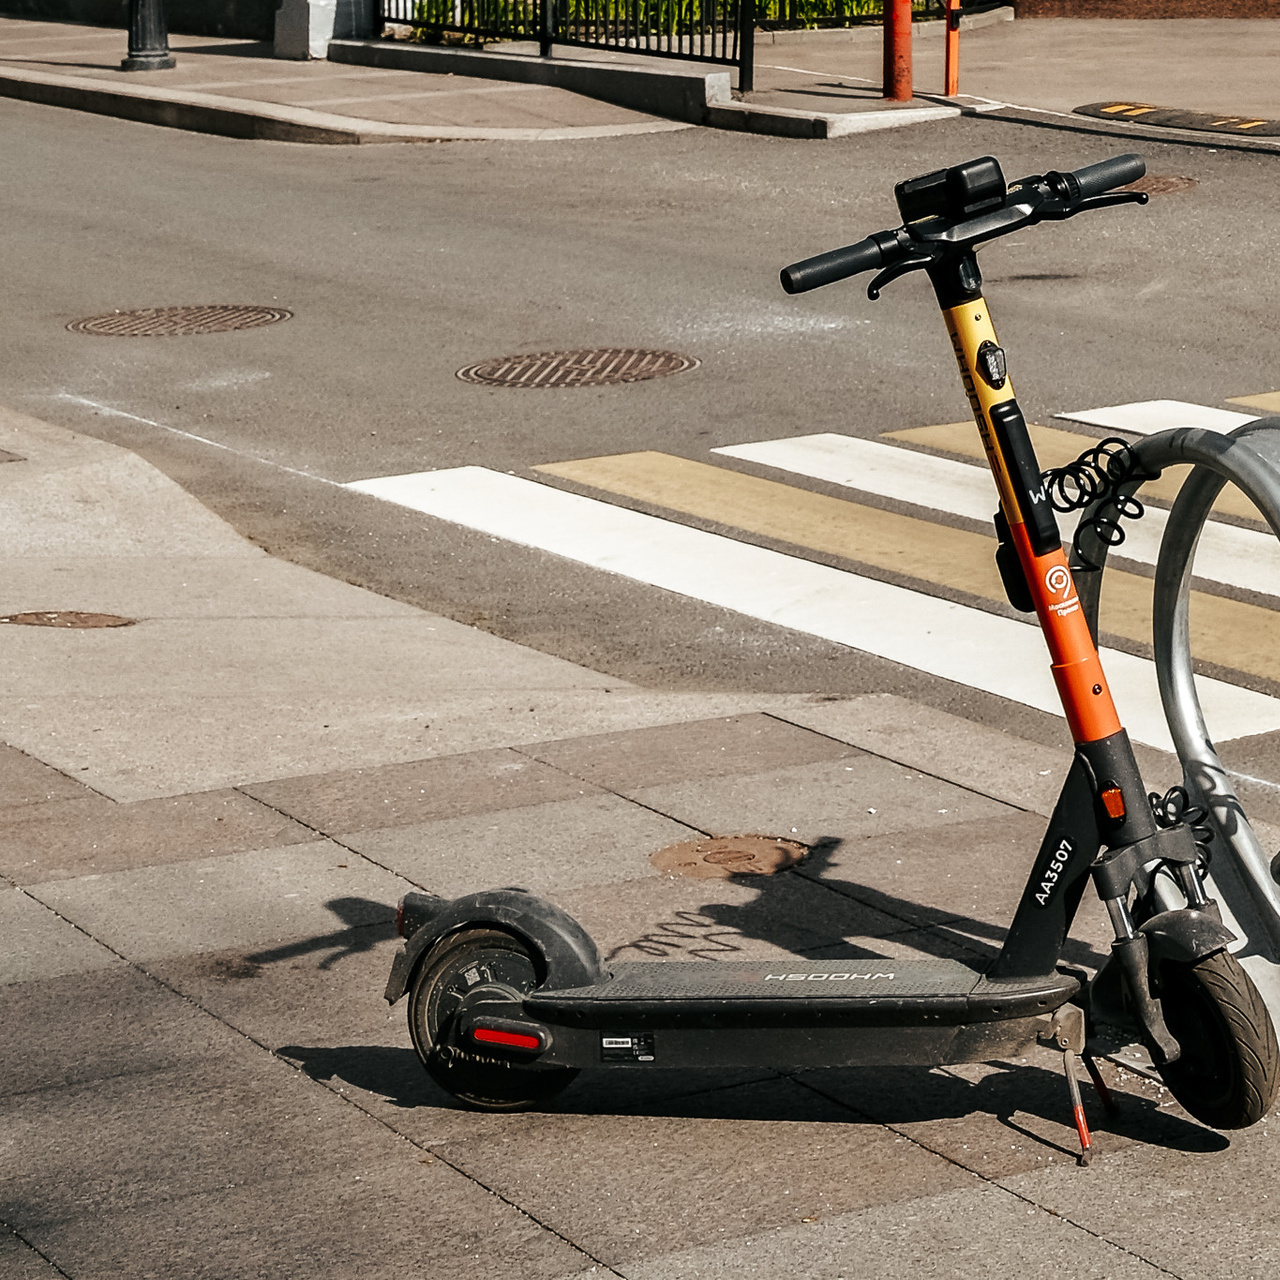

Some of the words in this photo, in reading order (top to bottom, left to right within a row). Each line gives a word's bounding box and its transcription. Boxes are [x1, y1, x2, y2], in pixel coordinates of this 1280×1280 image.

[951, 332, 994, 451] WHOOSH
[1035, 839, 1073, 906] AA3507
[764, 972, 895, 981] WHOOSH
